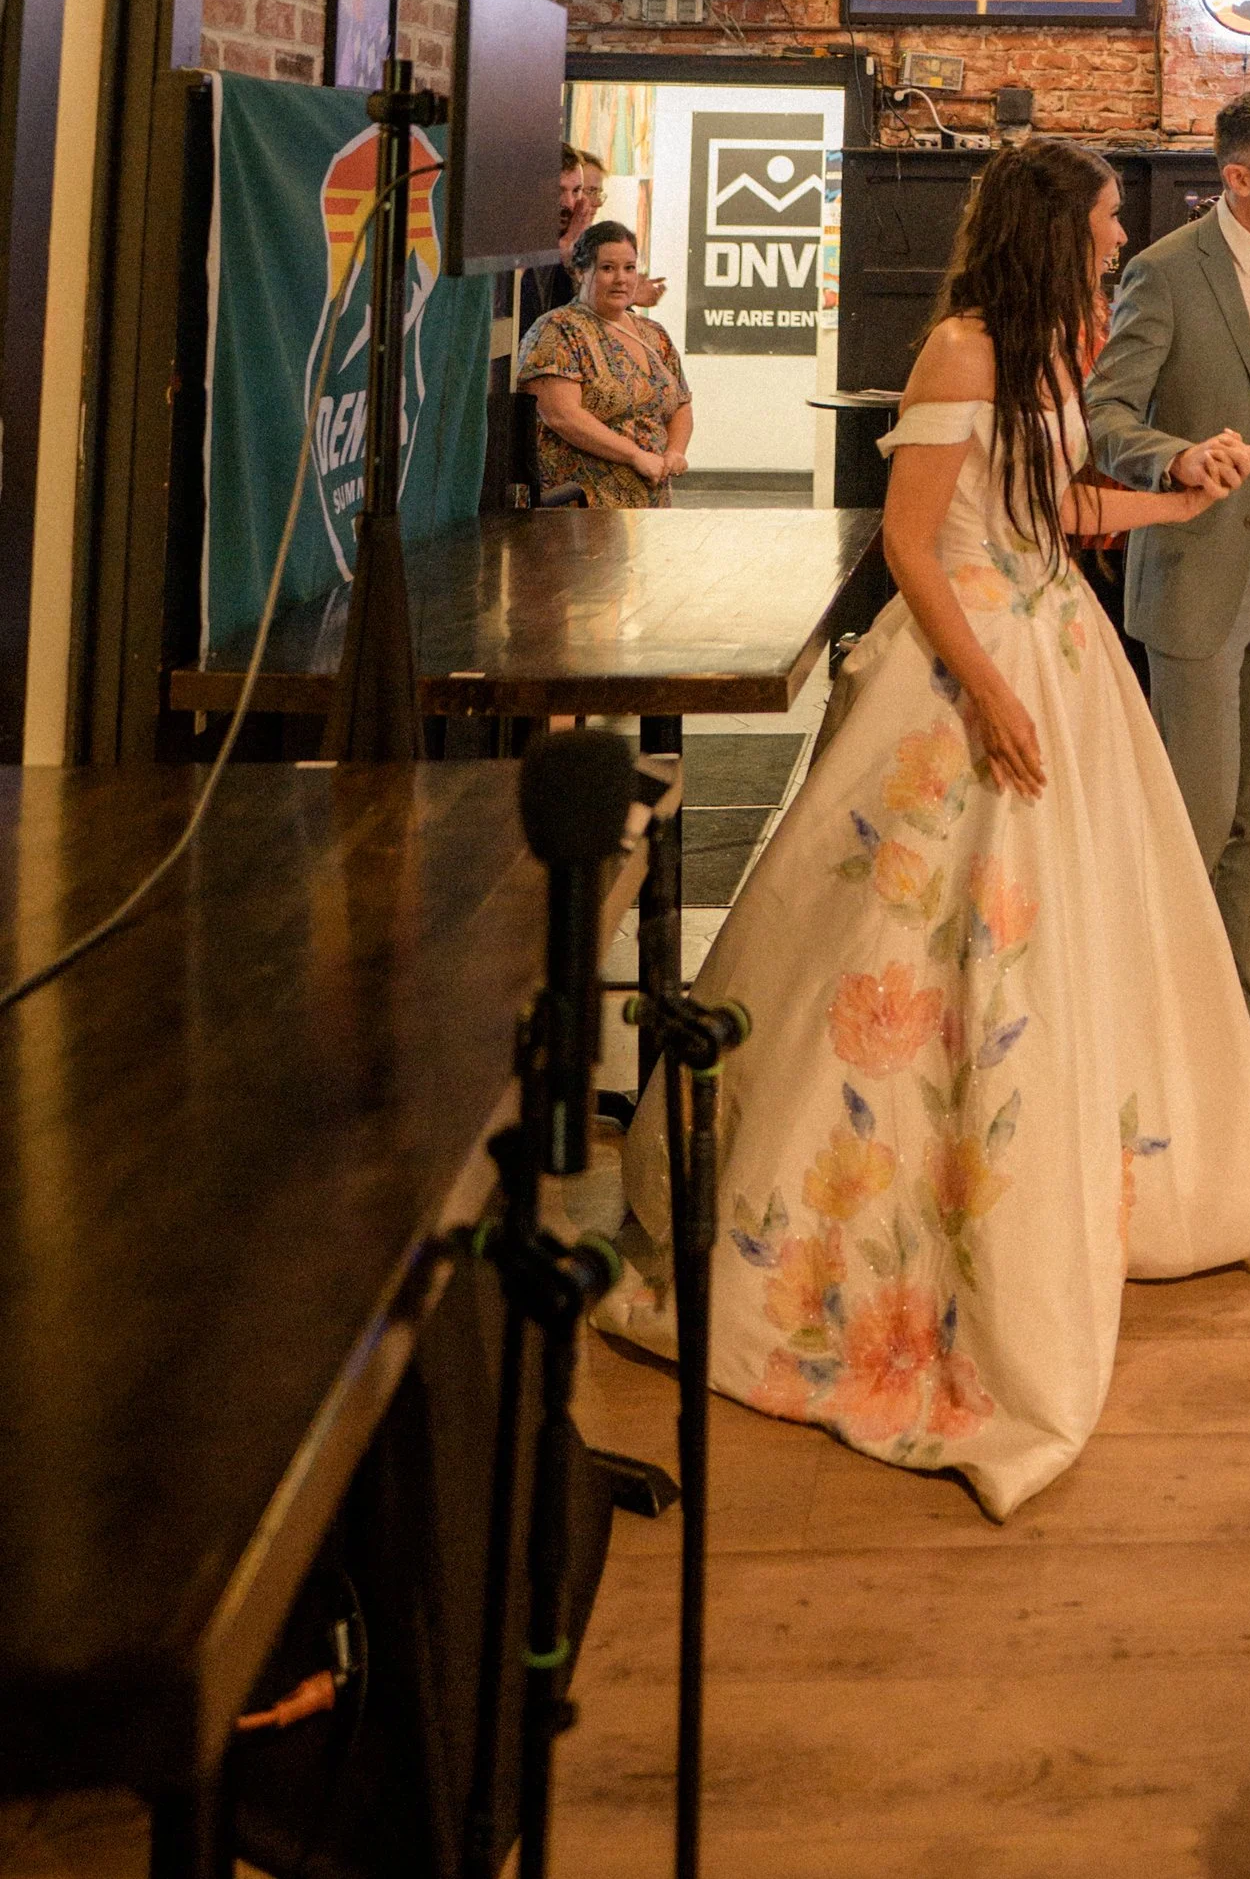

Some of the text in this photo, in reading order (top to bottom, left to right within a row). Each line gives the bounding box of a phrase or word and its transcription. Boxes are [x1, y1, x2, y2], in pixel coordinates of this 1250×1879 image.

[704, 242, 819, 288] DNV
[704, 309, 735, 326] WE
[736, 309, 774, 327] ARE
